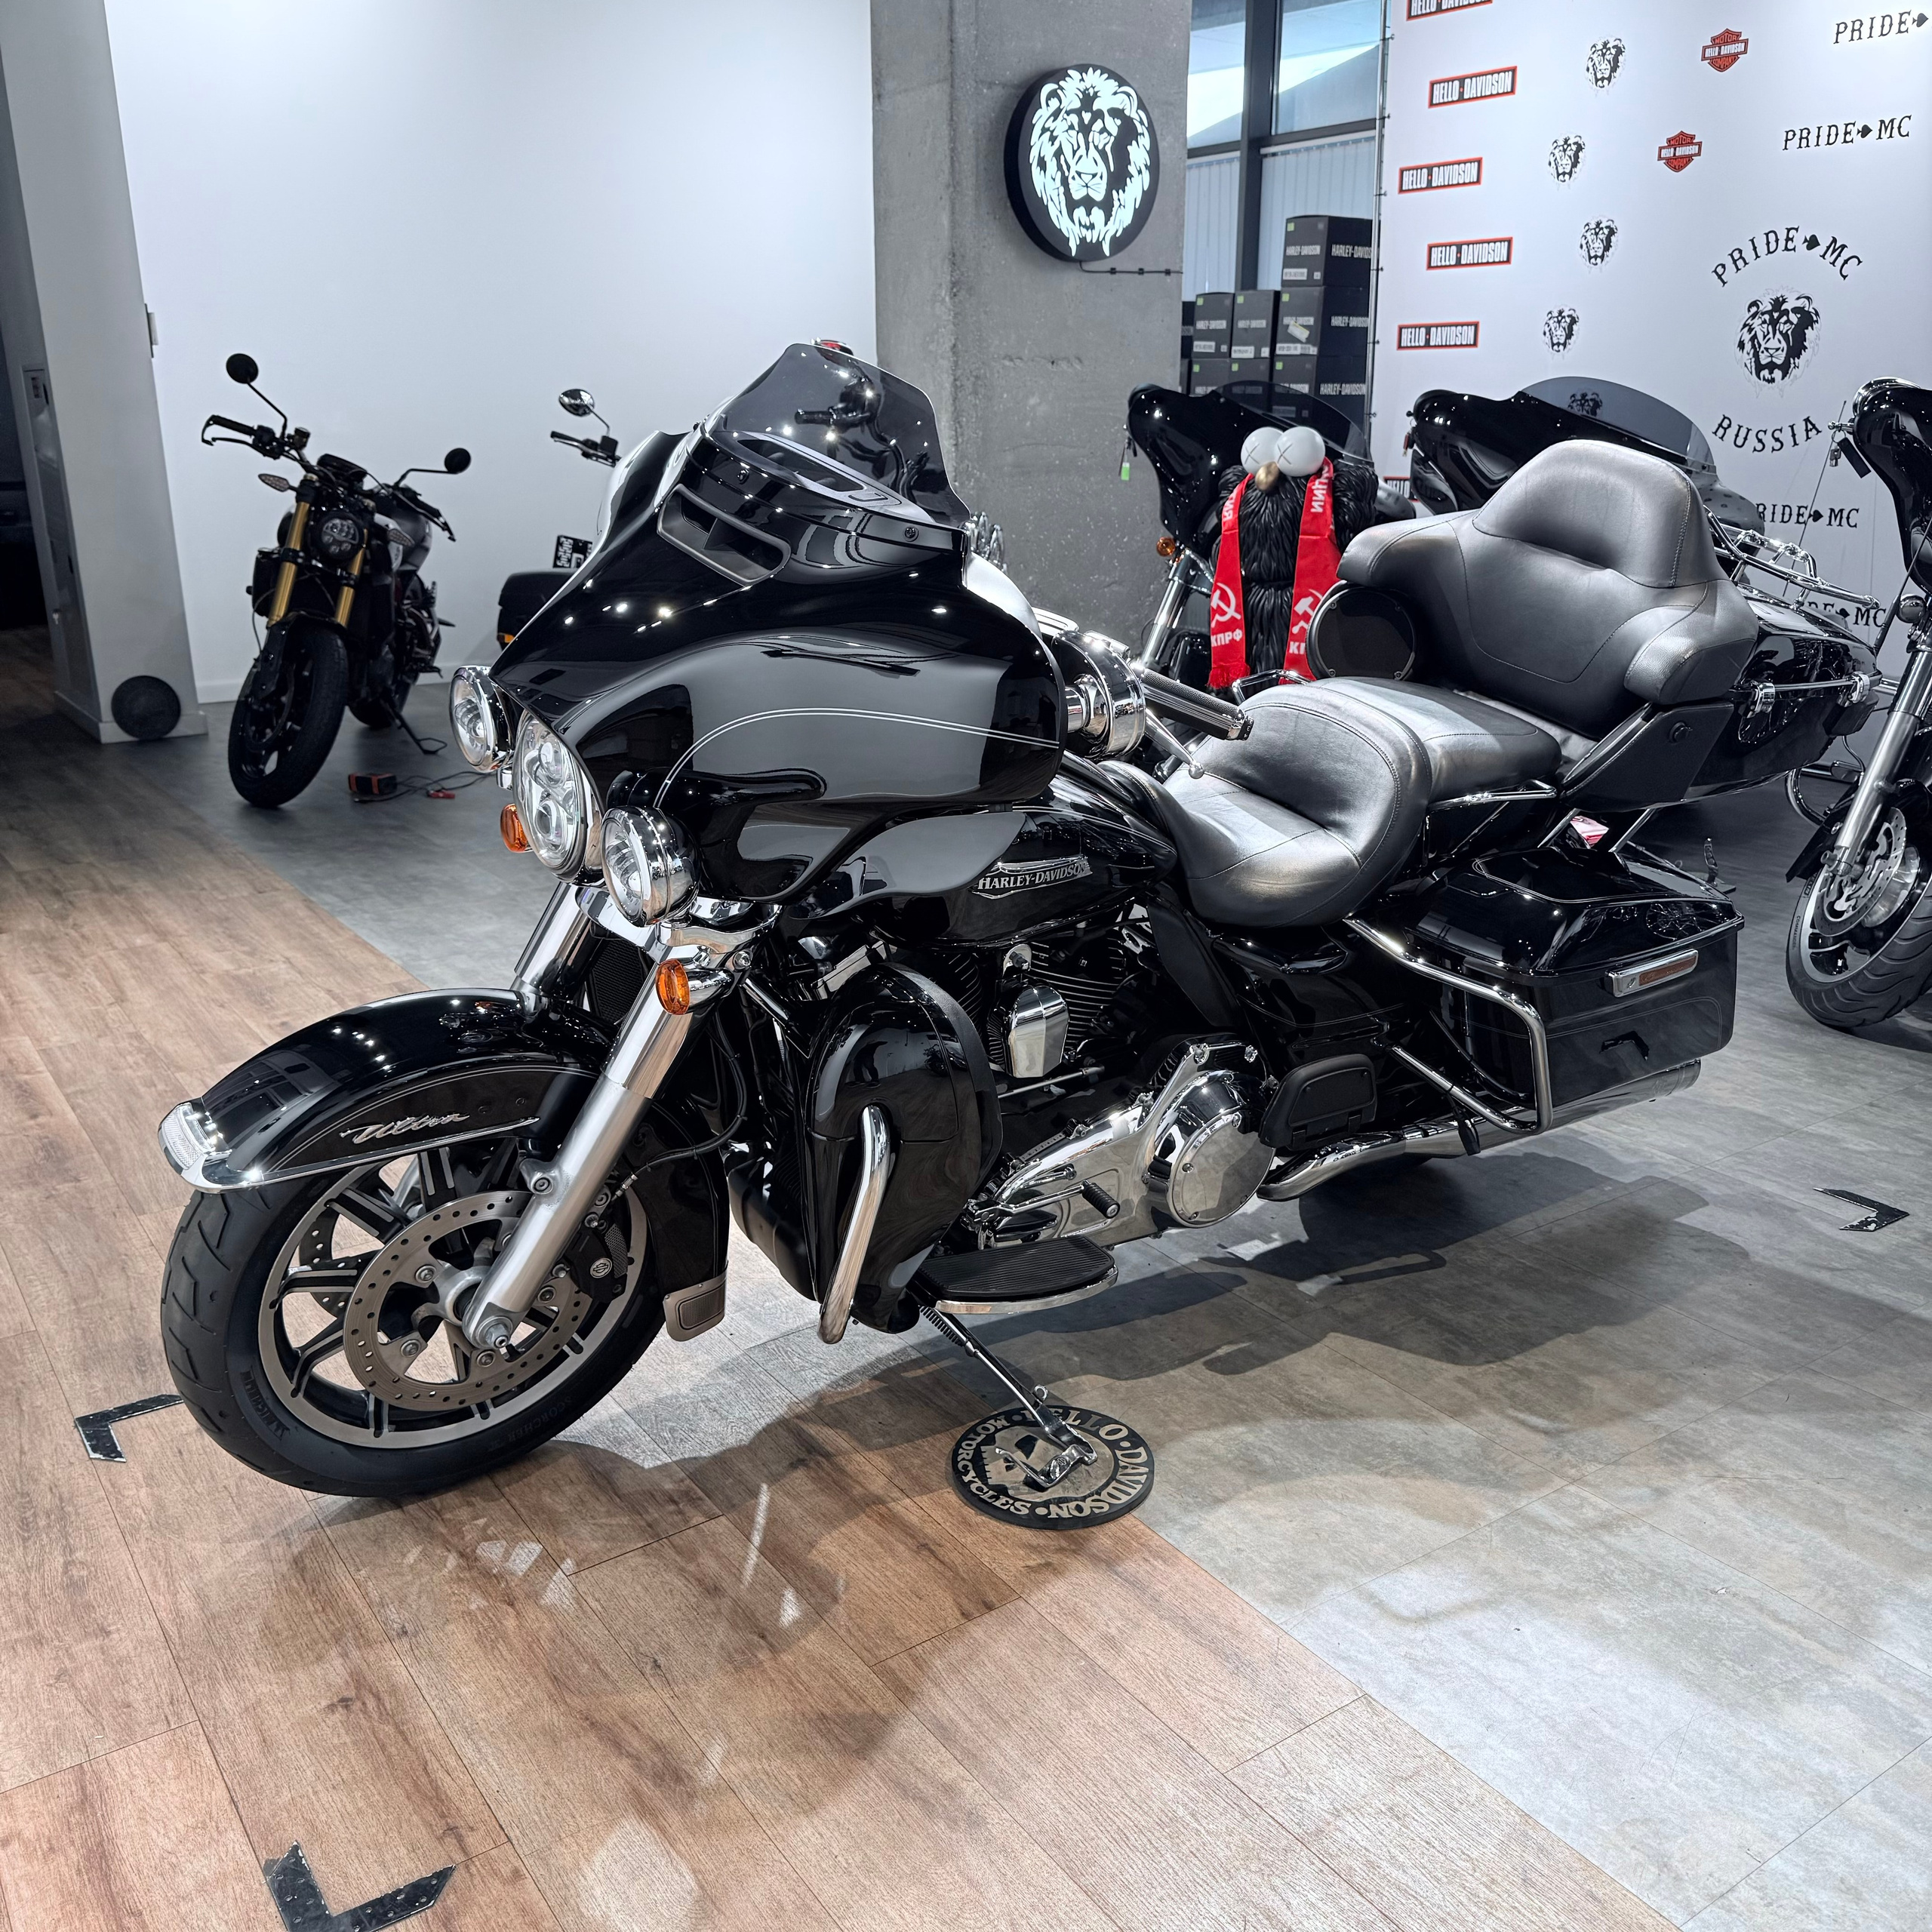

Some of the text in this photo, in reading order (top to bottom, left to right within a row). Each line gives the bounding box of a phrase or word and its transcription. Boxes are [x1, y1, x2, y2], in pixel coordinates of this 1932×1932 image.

[1715, 32, 1737, 44] MOTOR
[1833, 9, 1912, 44] PRIDE
[1721, 43, 1745, 55] DAVIDSON
[1432, 71, 1512, 104] HELLO DAVIDSON
[1670, 134, 1691, 145] MOTOR
[1782, 115, 1912, 150] PRIDE MC
[1402, 162, 1478, 190] HELLO DAVIDSON
[1331, 244, 1372, 259] HARLEY-DAVIDS
[1430, 241, 1509, 266] HELLO DAVIDSON
[1711, 225, 1863, 288] PRIDE MC
[1401, 325, 1475, 347] HELLO DAVIDSON
[1711, 414, 1823, 453] RUSSIA
[1755, 503, 1860, 528] RIDE MC
[1852, 606, 1887, 627] MC
[1211, 629, 1243, 648] КПРФ
[977, 861, 1088, 890] HARLEY-DAVIDSON
[956, 1414, 1032, 1515] MOTORCYCLES
[1048, 1445, 1149, 1519] DAVIDSON
